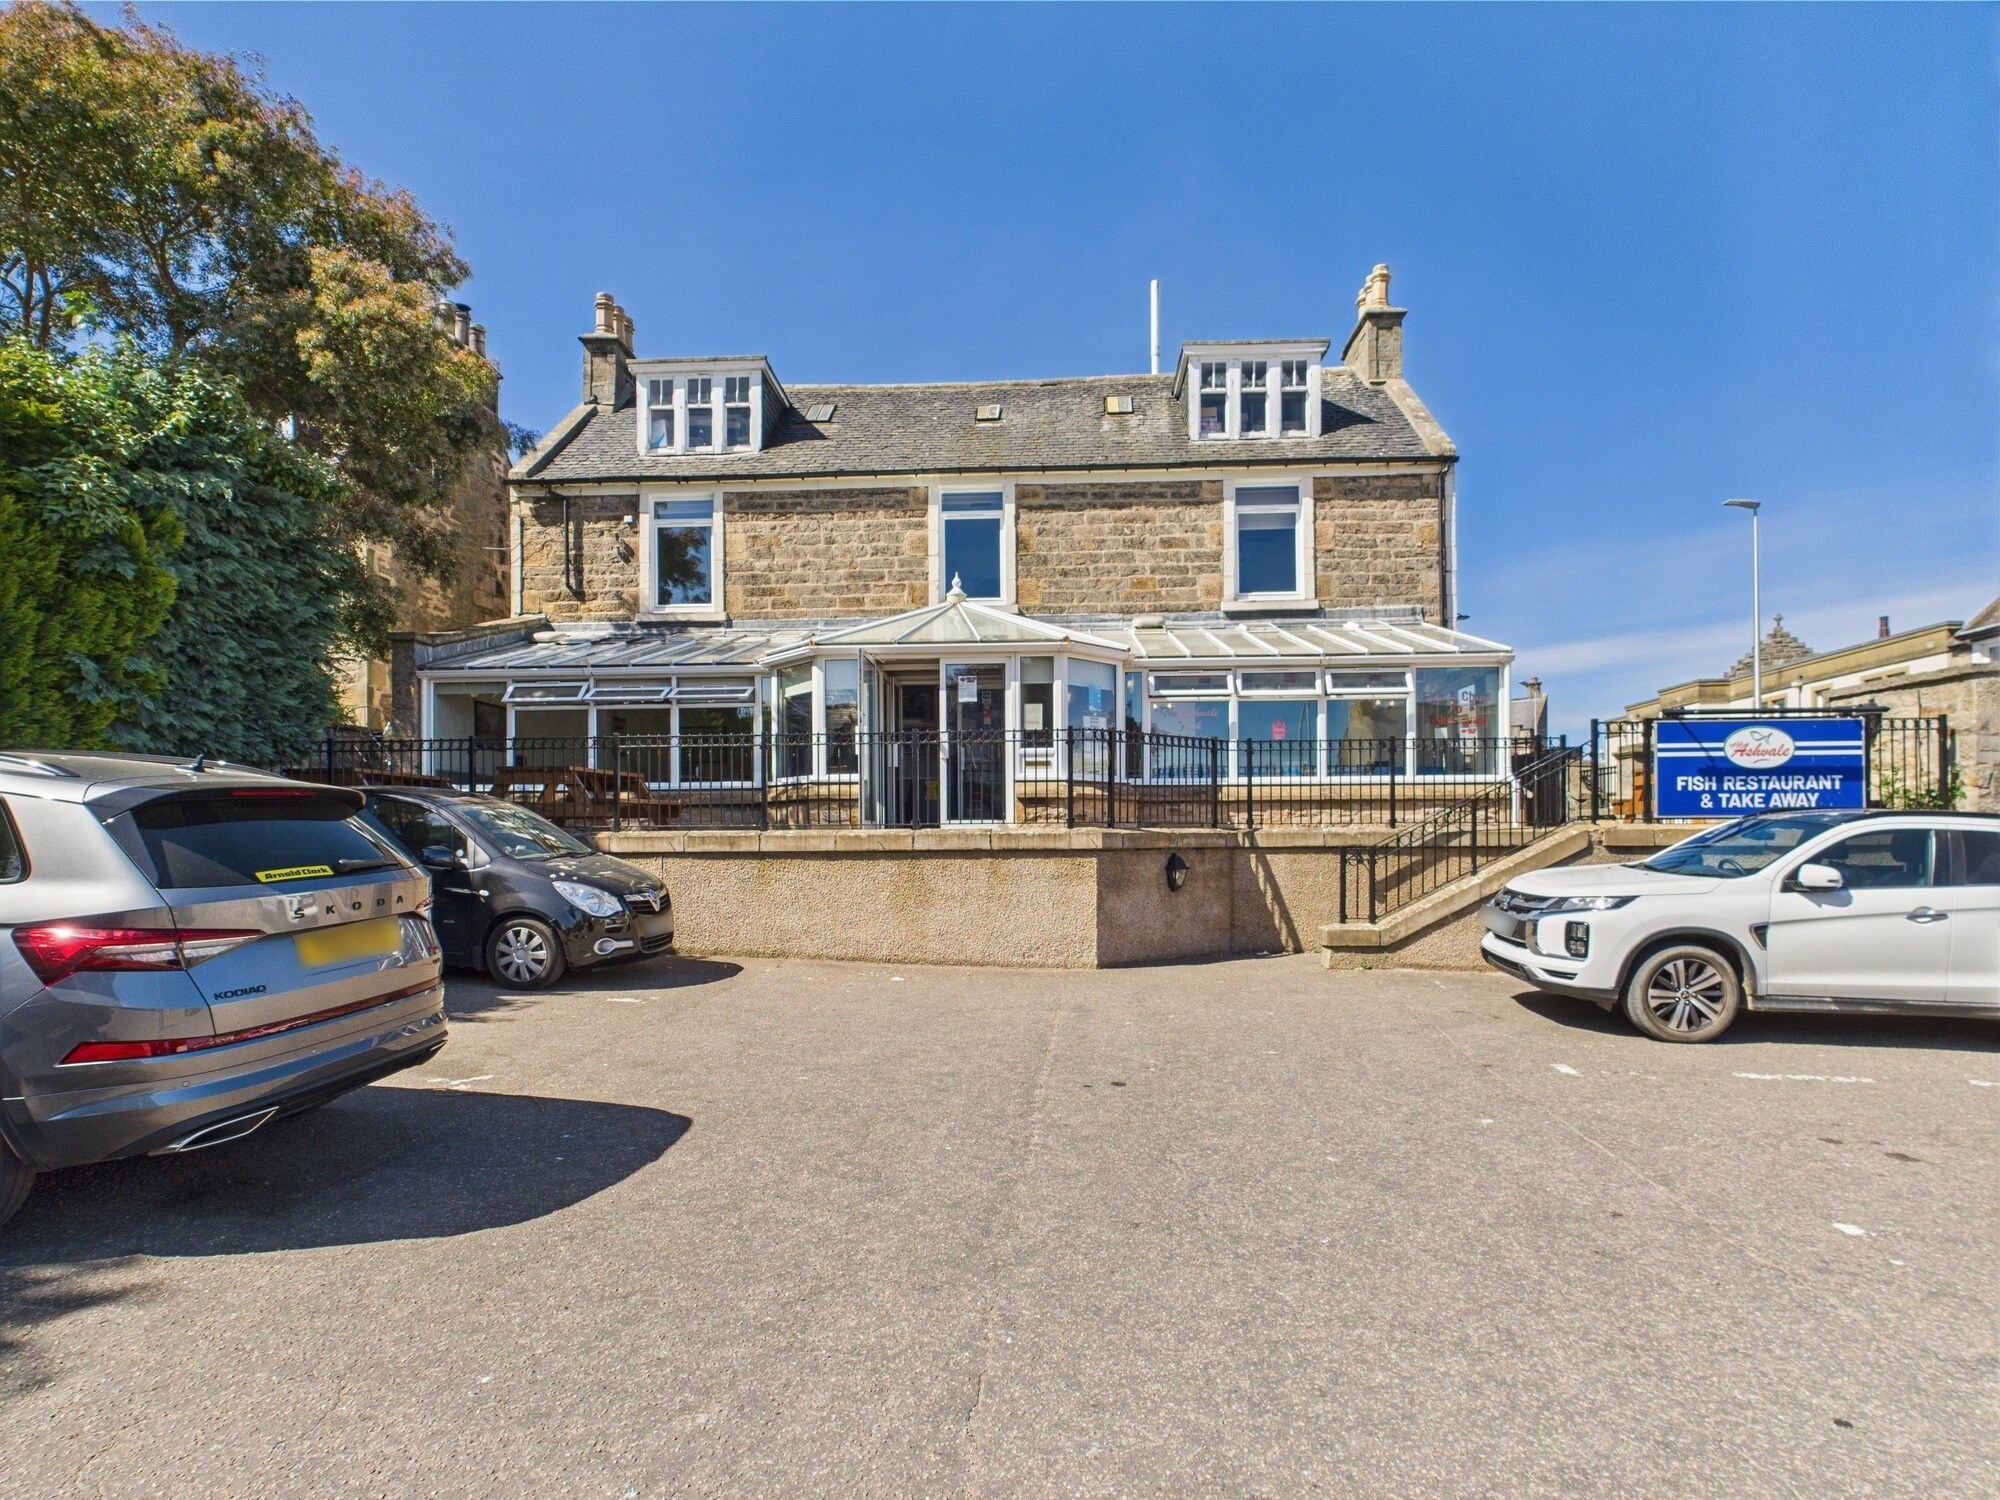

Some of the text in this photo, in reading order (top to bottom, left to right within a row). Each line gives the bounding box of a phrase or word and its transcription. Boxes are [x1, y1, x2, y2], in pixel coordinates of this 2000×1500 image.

[1730, 742, 1790, 758] Ashvale
[1676, 775, 1843, 791] FISH RESTAURANT
[1700, 793, 1820, 808] & TAKE AWAY
[264, 867, 329, 880] Arnold Clark
[213, 984, 267, 1001] KODIAQ
